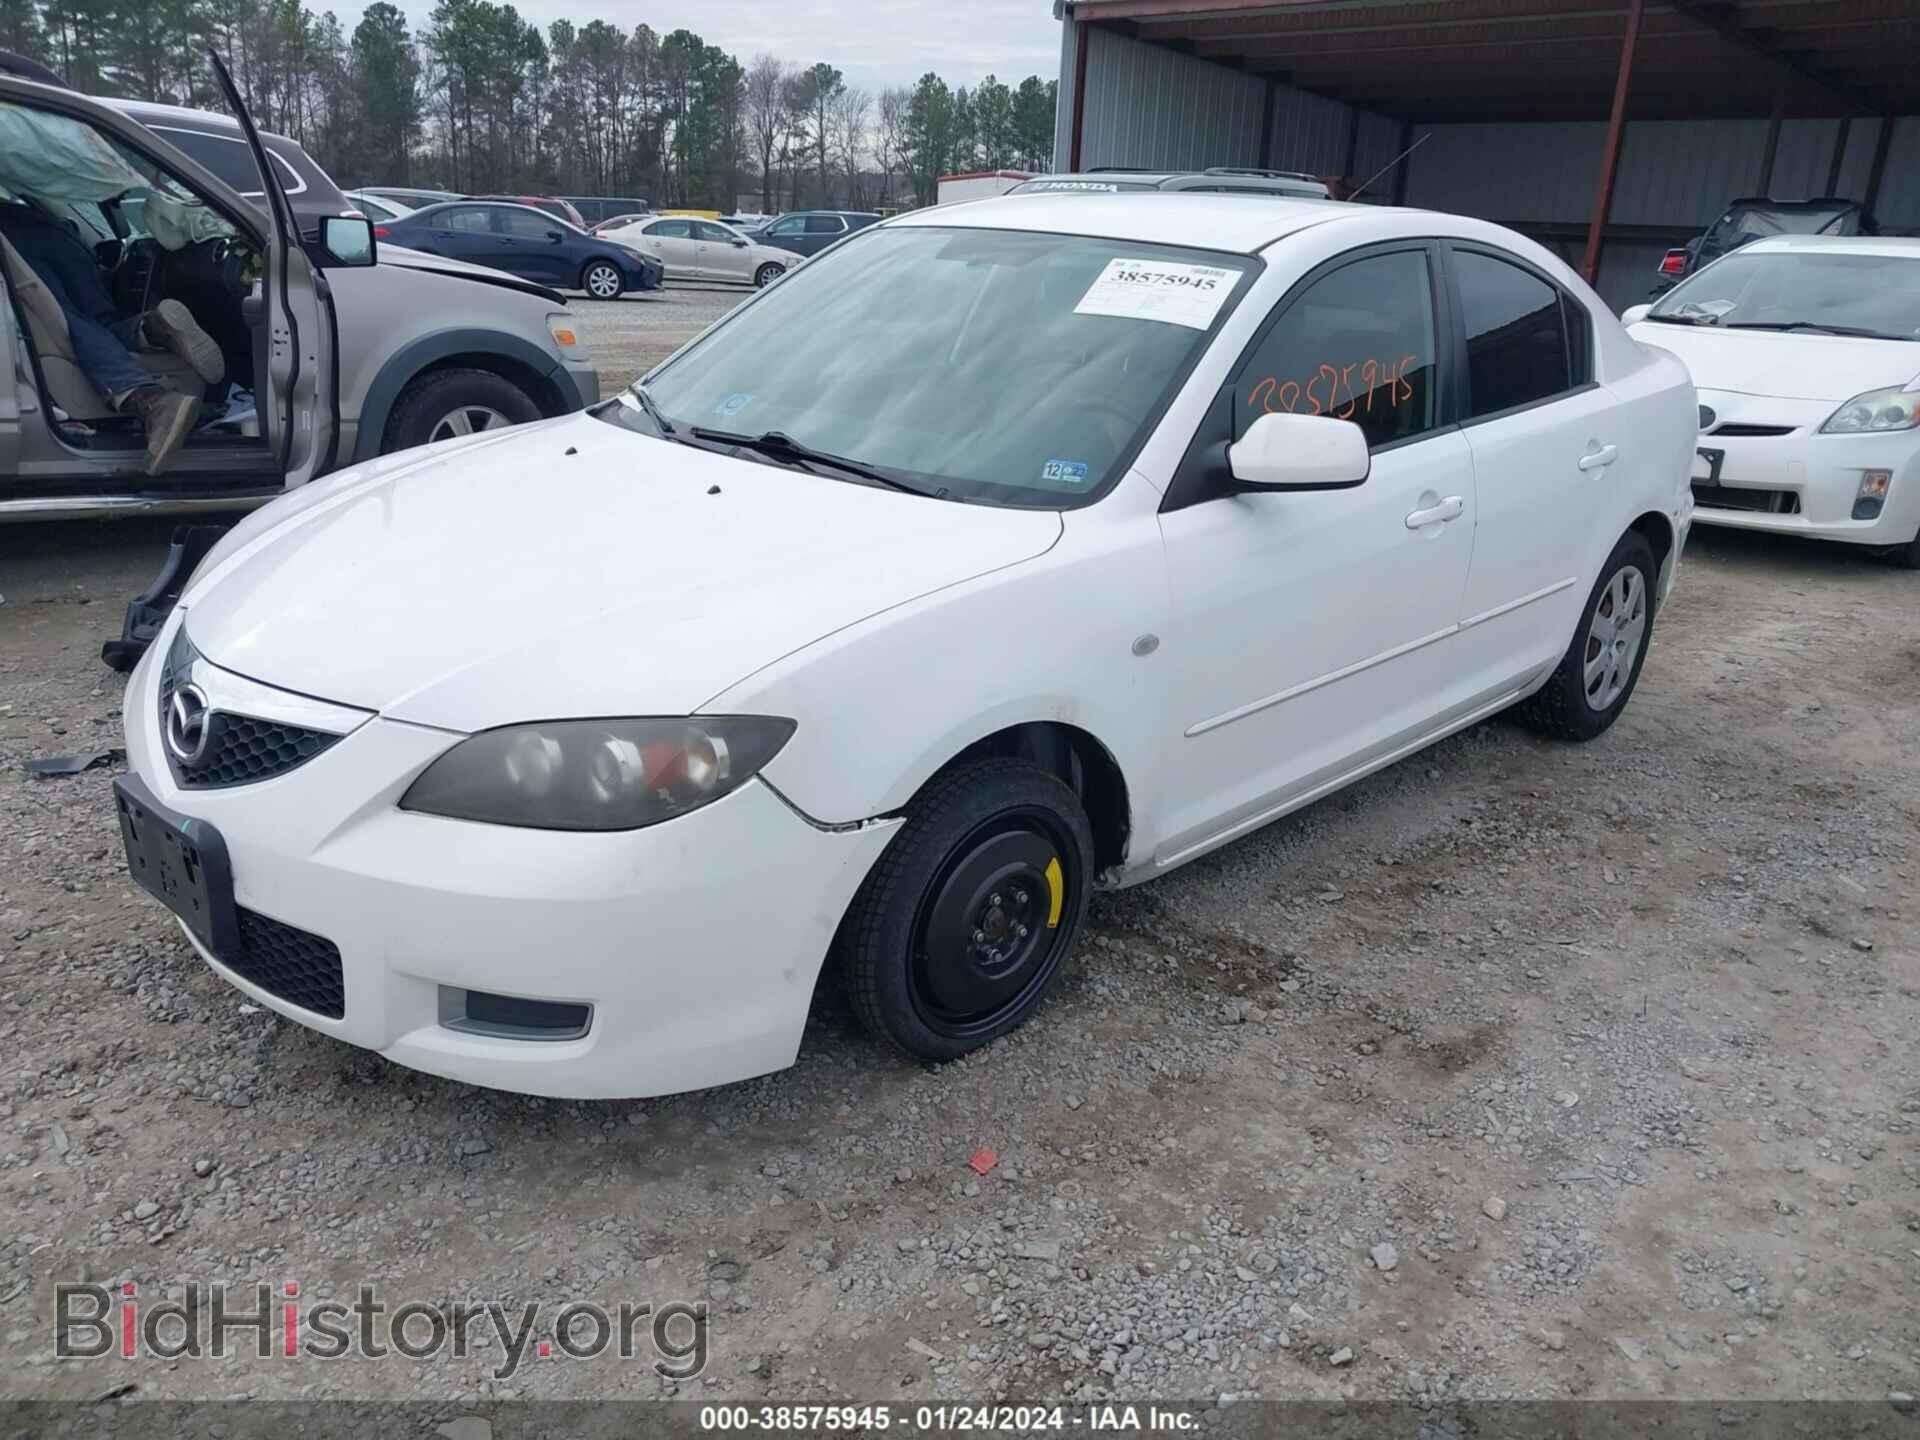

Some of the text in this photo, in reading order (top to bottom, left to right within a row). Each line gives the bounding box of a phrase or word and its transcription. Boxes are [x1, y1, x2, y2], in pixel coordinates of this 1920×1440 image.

[1049, 182, 1118, 193] HONDA
[1112, 270, 1217, 291] 38575945
[1047, 463, 1060, 477] 12
